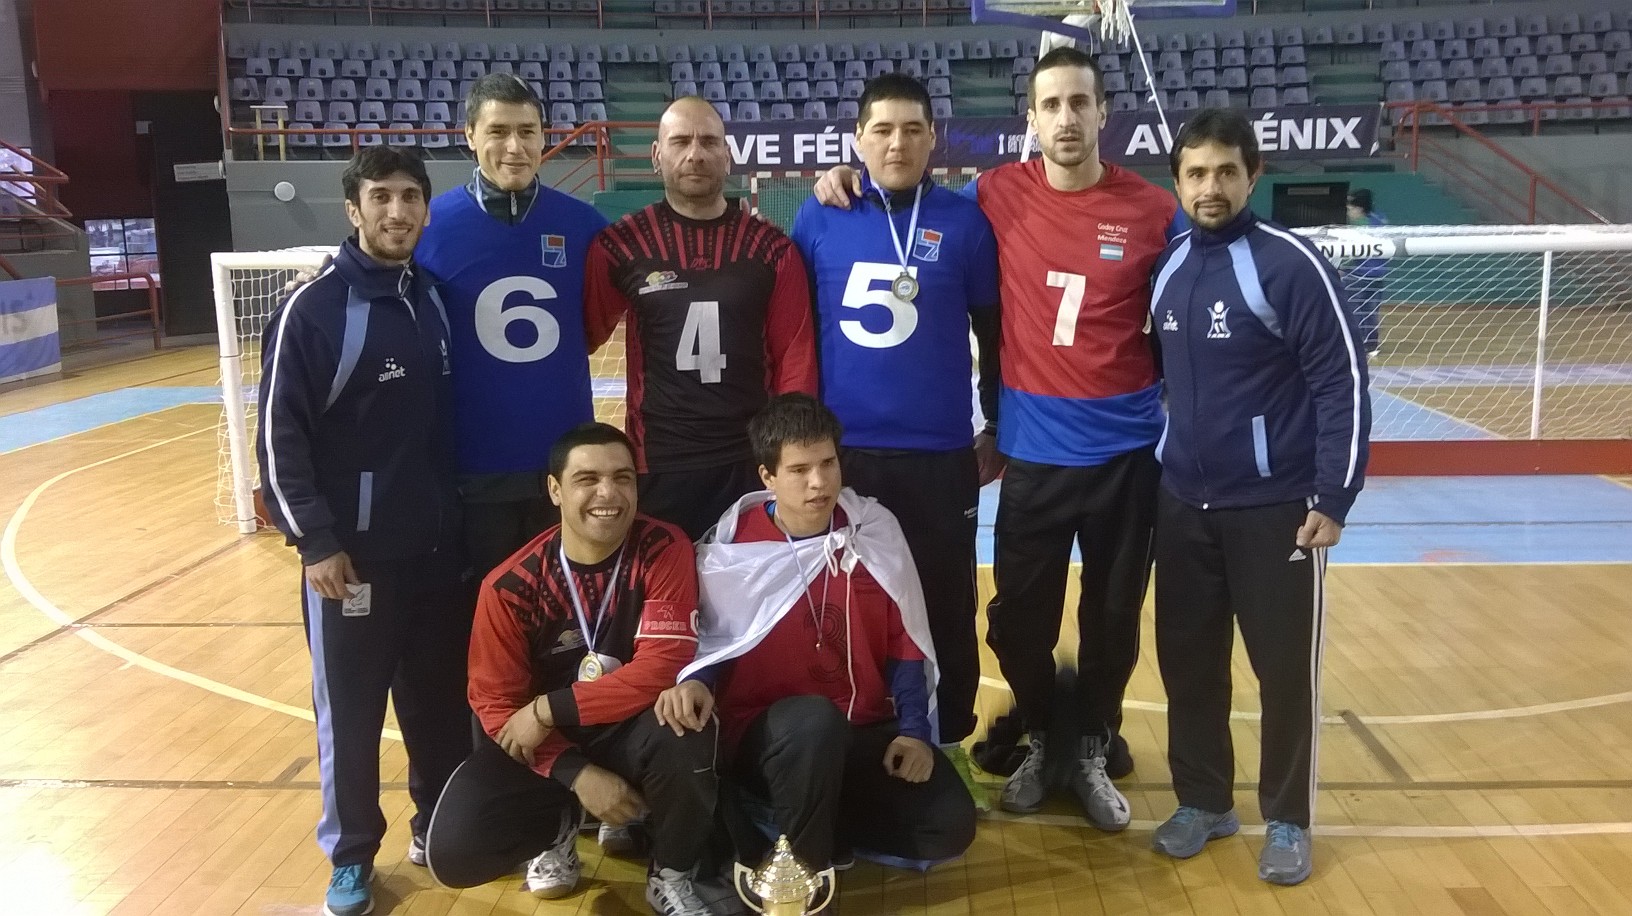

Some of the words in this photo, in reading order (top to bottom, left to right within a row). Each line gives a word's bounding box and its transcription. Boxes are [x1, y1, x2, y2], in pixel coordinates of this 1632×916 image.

[1250, 112, 1363, 151] ÉNIX
[1097, 222, 1115, 233] Godoy
[1097, 234, 1127, 244] Mendoza
[1340, 243, 1384, 258] LUIS
[474, 275, 560, 363] 6
[839, 261, 919, 349] 5
[1046, 270, 1087, 347] 7
[675, 301, 727, 384] 4
